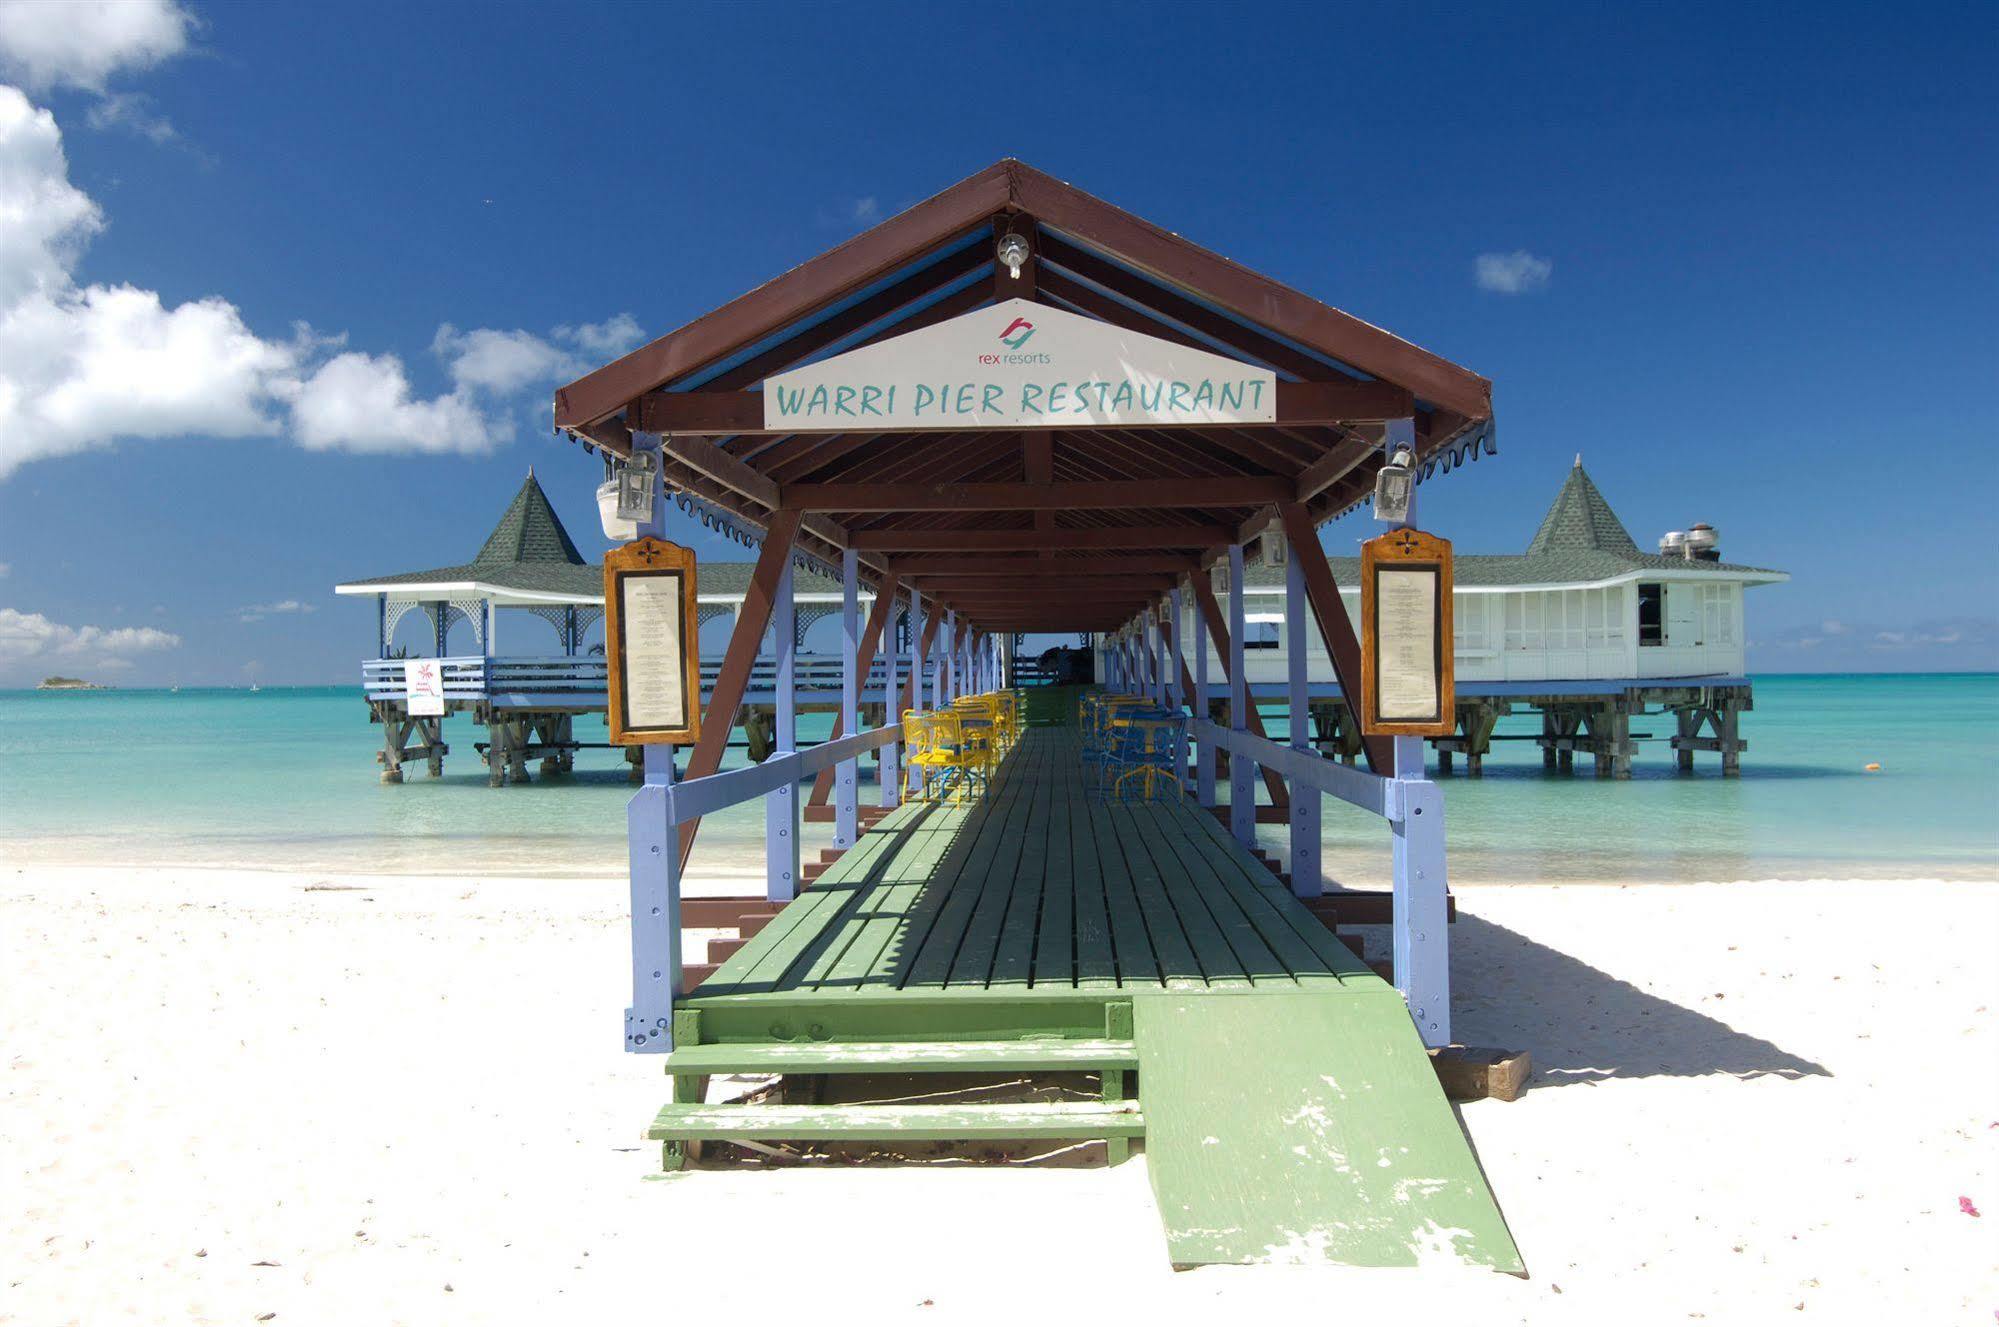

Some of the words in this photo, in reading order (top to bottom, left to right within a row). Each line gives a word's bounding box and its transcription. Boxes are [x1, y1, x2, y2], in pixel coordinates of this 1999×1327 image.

[979, 354, 1000, 365] rex
[1004, 353, 1051, 364] resorts
[777, 384, 896, 416] WARRI
[913, 384, 1004, 416] PIER
[1021, 379, 1266, 415] RESTAURANT
